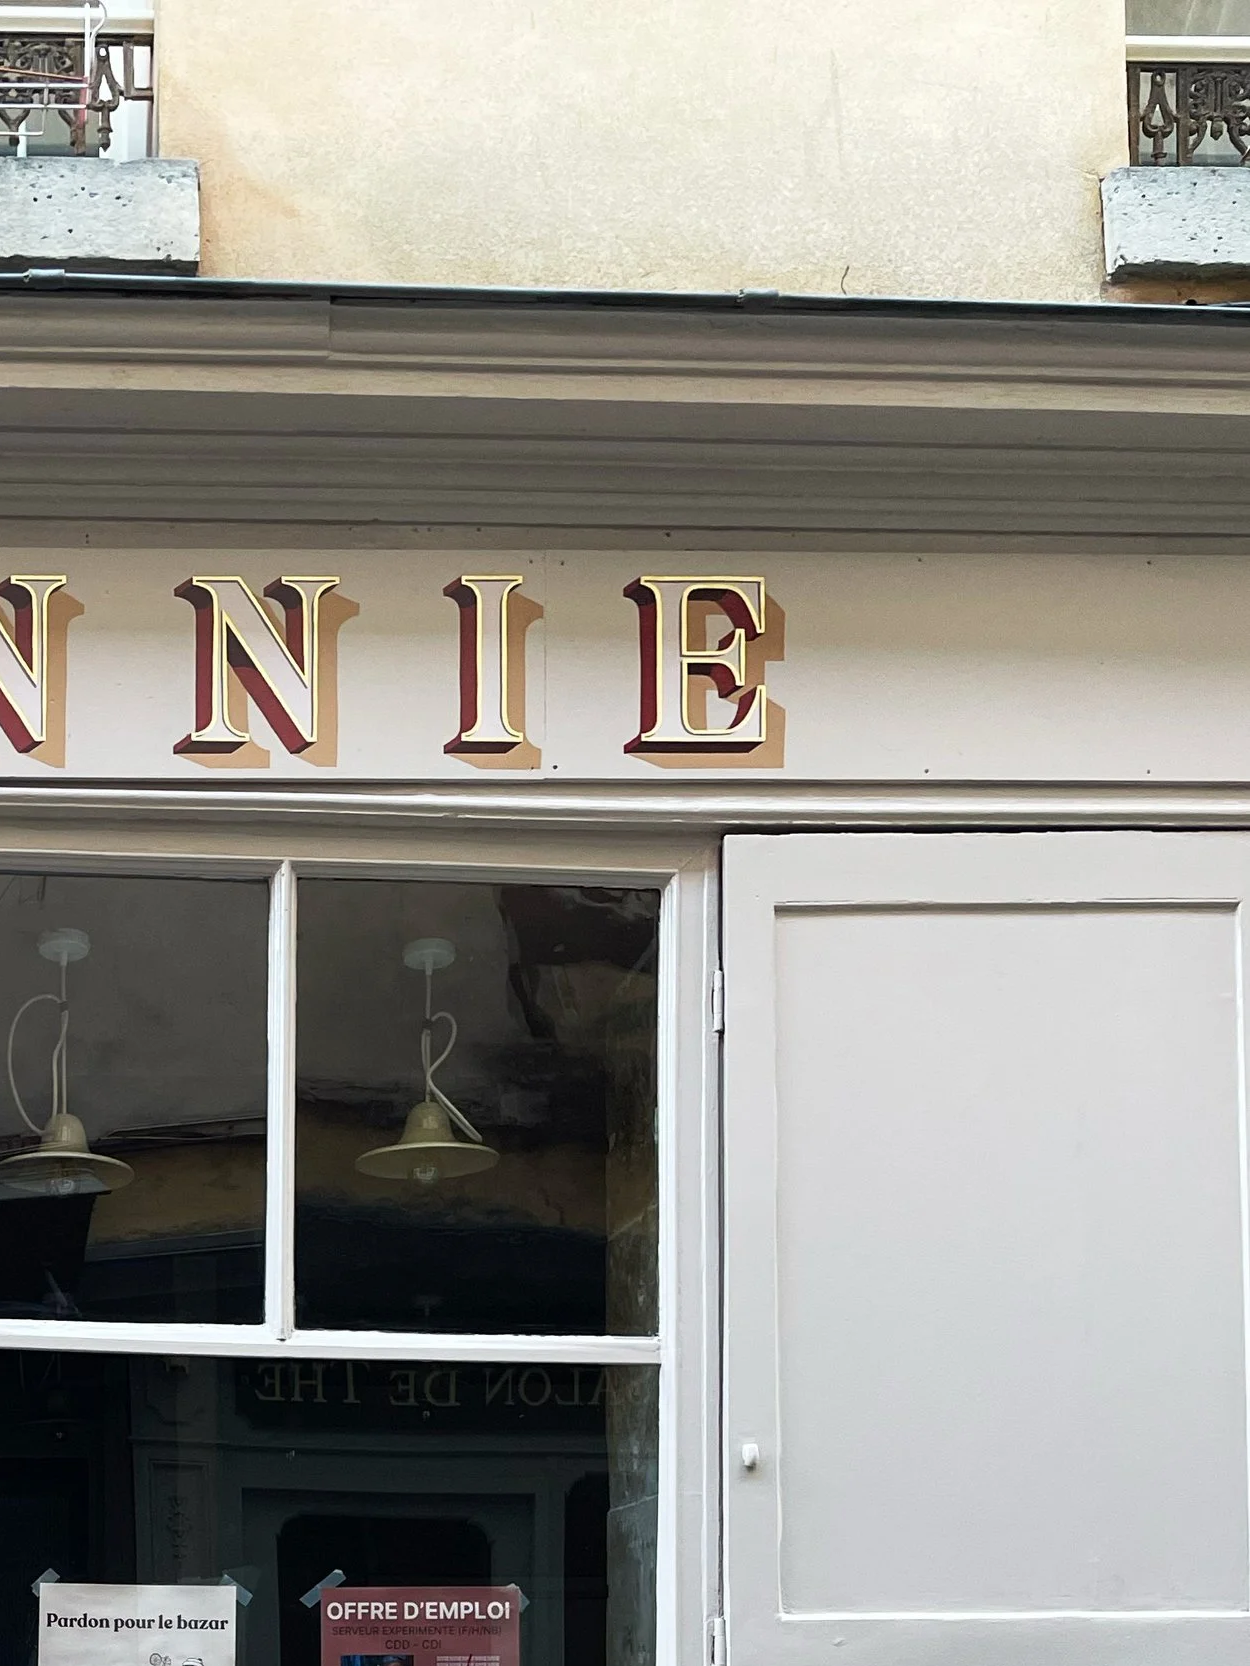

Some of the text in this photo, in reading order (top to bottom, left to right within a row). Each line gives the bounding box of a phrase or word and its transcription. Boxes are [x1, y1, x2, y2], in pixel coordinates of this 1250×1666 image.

[327, 1602, 398, 1620] OFFRE
[47, 1612, 228, 1632] Pardon pour le bazar
[332, 1626, 379, 1636] SERVEUR
[386, 1640, 410, 1649] CDD
[422, 1640, 442, 1649] CDI
